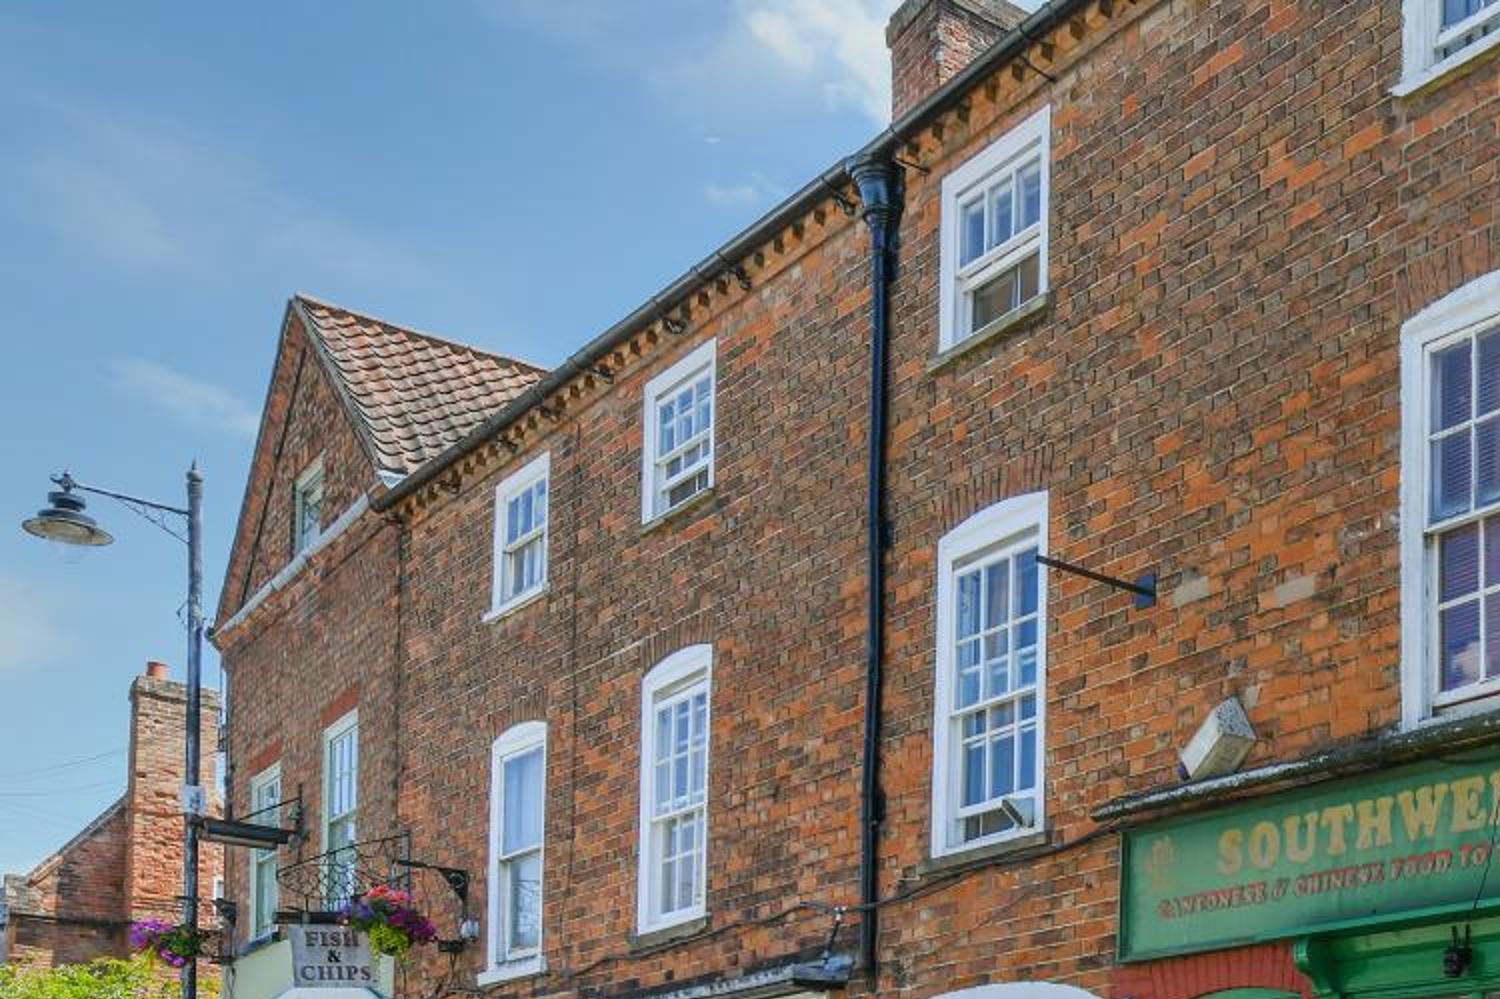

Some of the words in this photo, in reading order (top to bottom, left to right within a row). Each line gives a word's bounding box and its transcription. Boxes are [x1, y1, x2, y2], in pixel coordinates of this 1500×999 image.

[1158, 881, 1267, 919] CANTONESE
[1295, 862, 1385, 896] CHINESE
[1391, 847, 1453, 880] FOOD
[1460, 843, 1490, 866] TO
[304, 928, 360, 947] FISH
[327, 948, 341, 963] &
[301, 965, 372, 981] CHIPS
